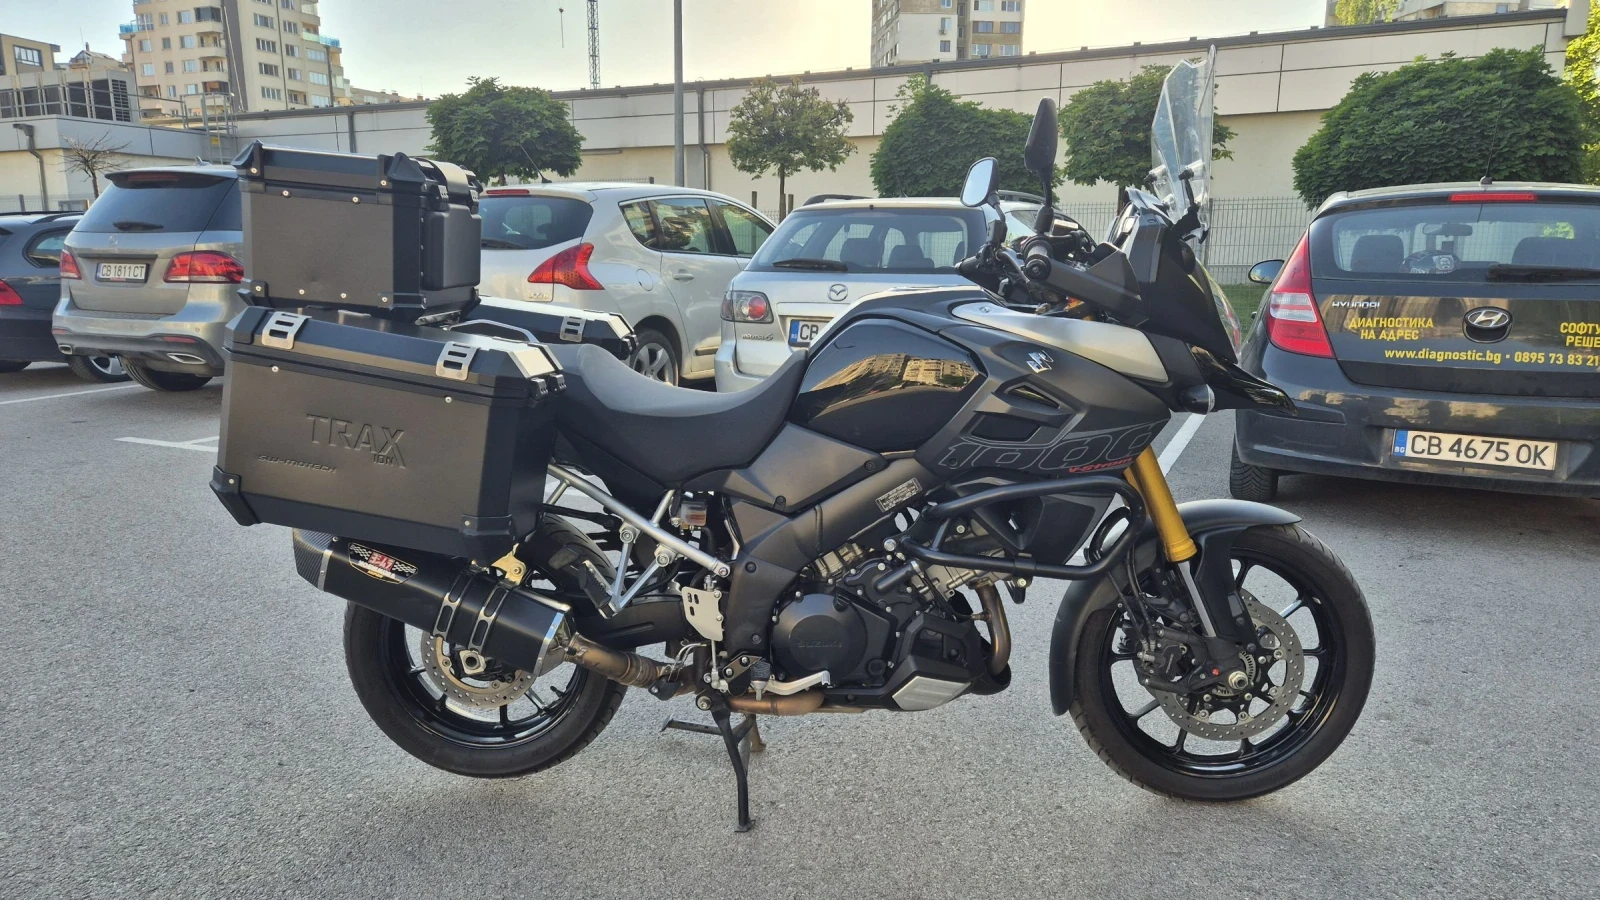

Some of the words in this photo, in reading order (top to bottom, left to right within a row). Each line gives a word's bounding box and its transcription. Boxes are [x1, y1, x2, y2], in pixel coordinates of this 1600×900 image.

[101, 265, 111, 276] CB
[113, 265, 132, 277] 1811
[133, 265, 144, 277] CT
[1349, 317, 1434, 330] ДИАГНОСТИКА
[1360, 330, 1376, 340] НА
[1378, 329, 1419, 342] АДРЕС
[1384, 348, 1502, 364] www.diagnostic.bg
[1514, 352, 1545, 364] 0895
[1549, 352, 1563, 365] 73
[1567, 353, 1582, 366] 83
[1586, 354, 1599, 367] 21
[306, 413, 406, 469] TRAX
[938, 420, 1169, 470] 1000
[1411, 434, 1442, 456] CB
[1448, 437, 1510, 462] 4675
[1516, 443, 1550, 467] OK
